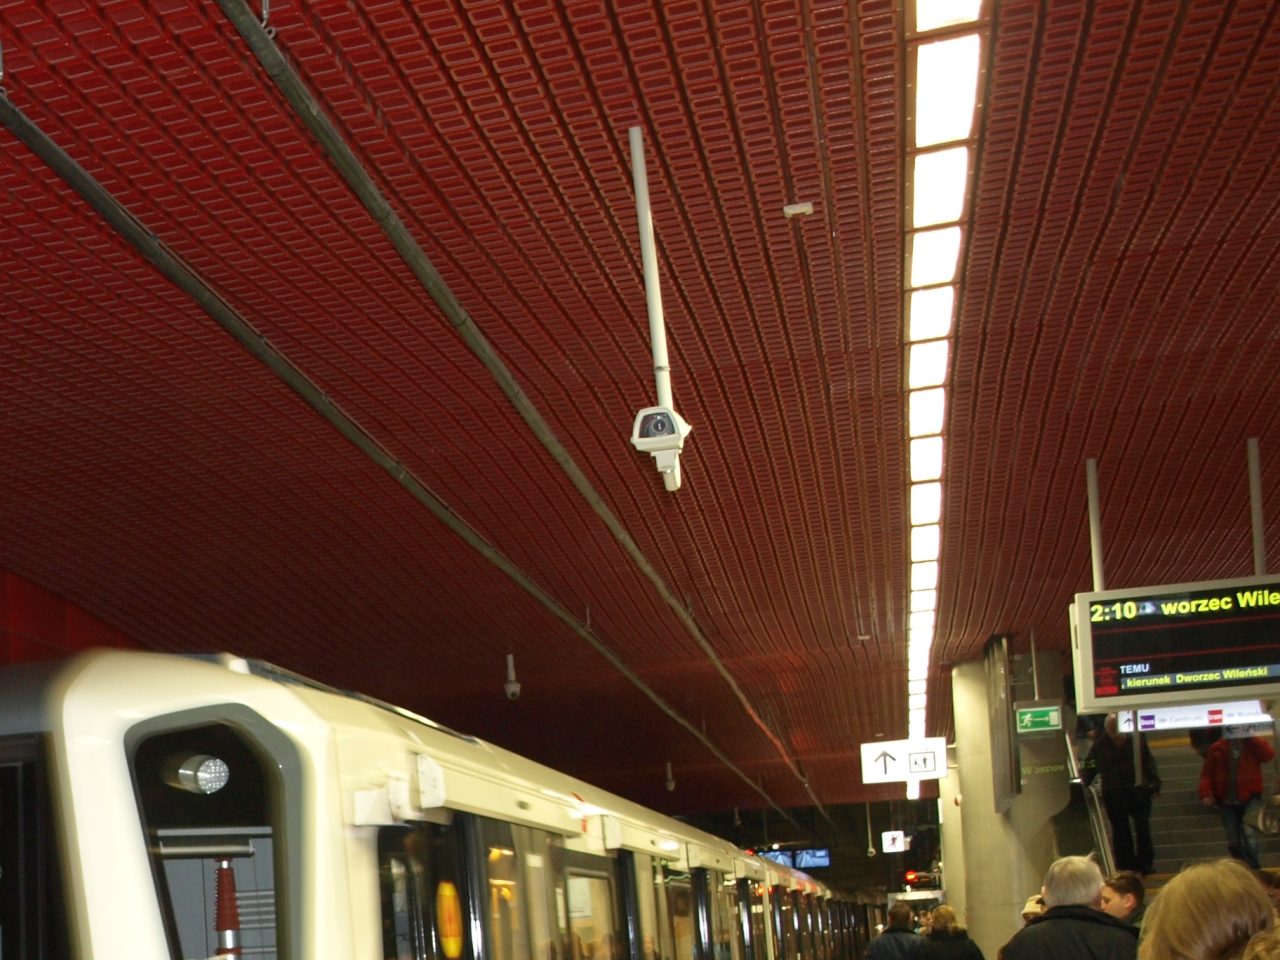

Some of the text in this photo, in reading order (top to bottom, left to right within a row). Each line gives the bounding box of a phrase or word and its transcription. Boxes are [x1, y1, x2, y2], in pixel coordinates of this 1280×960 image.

[1090, 601, 1137, 622] 2:10
[1161, 596, 1232, 615] worzec
[1120, 663, 1149, 674] TEMU
[1127, 676, 1170, 688] kierunek
[1176, 670, 1220, 683] Dworzec
